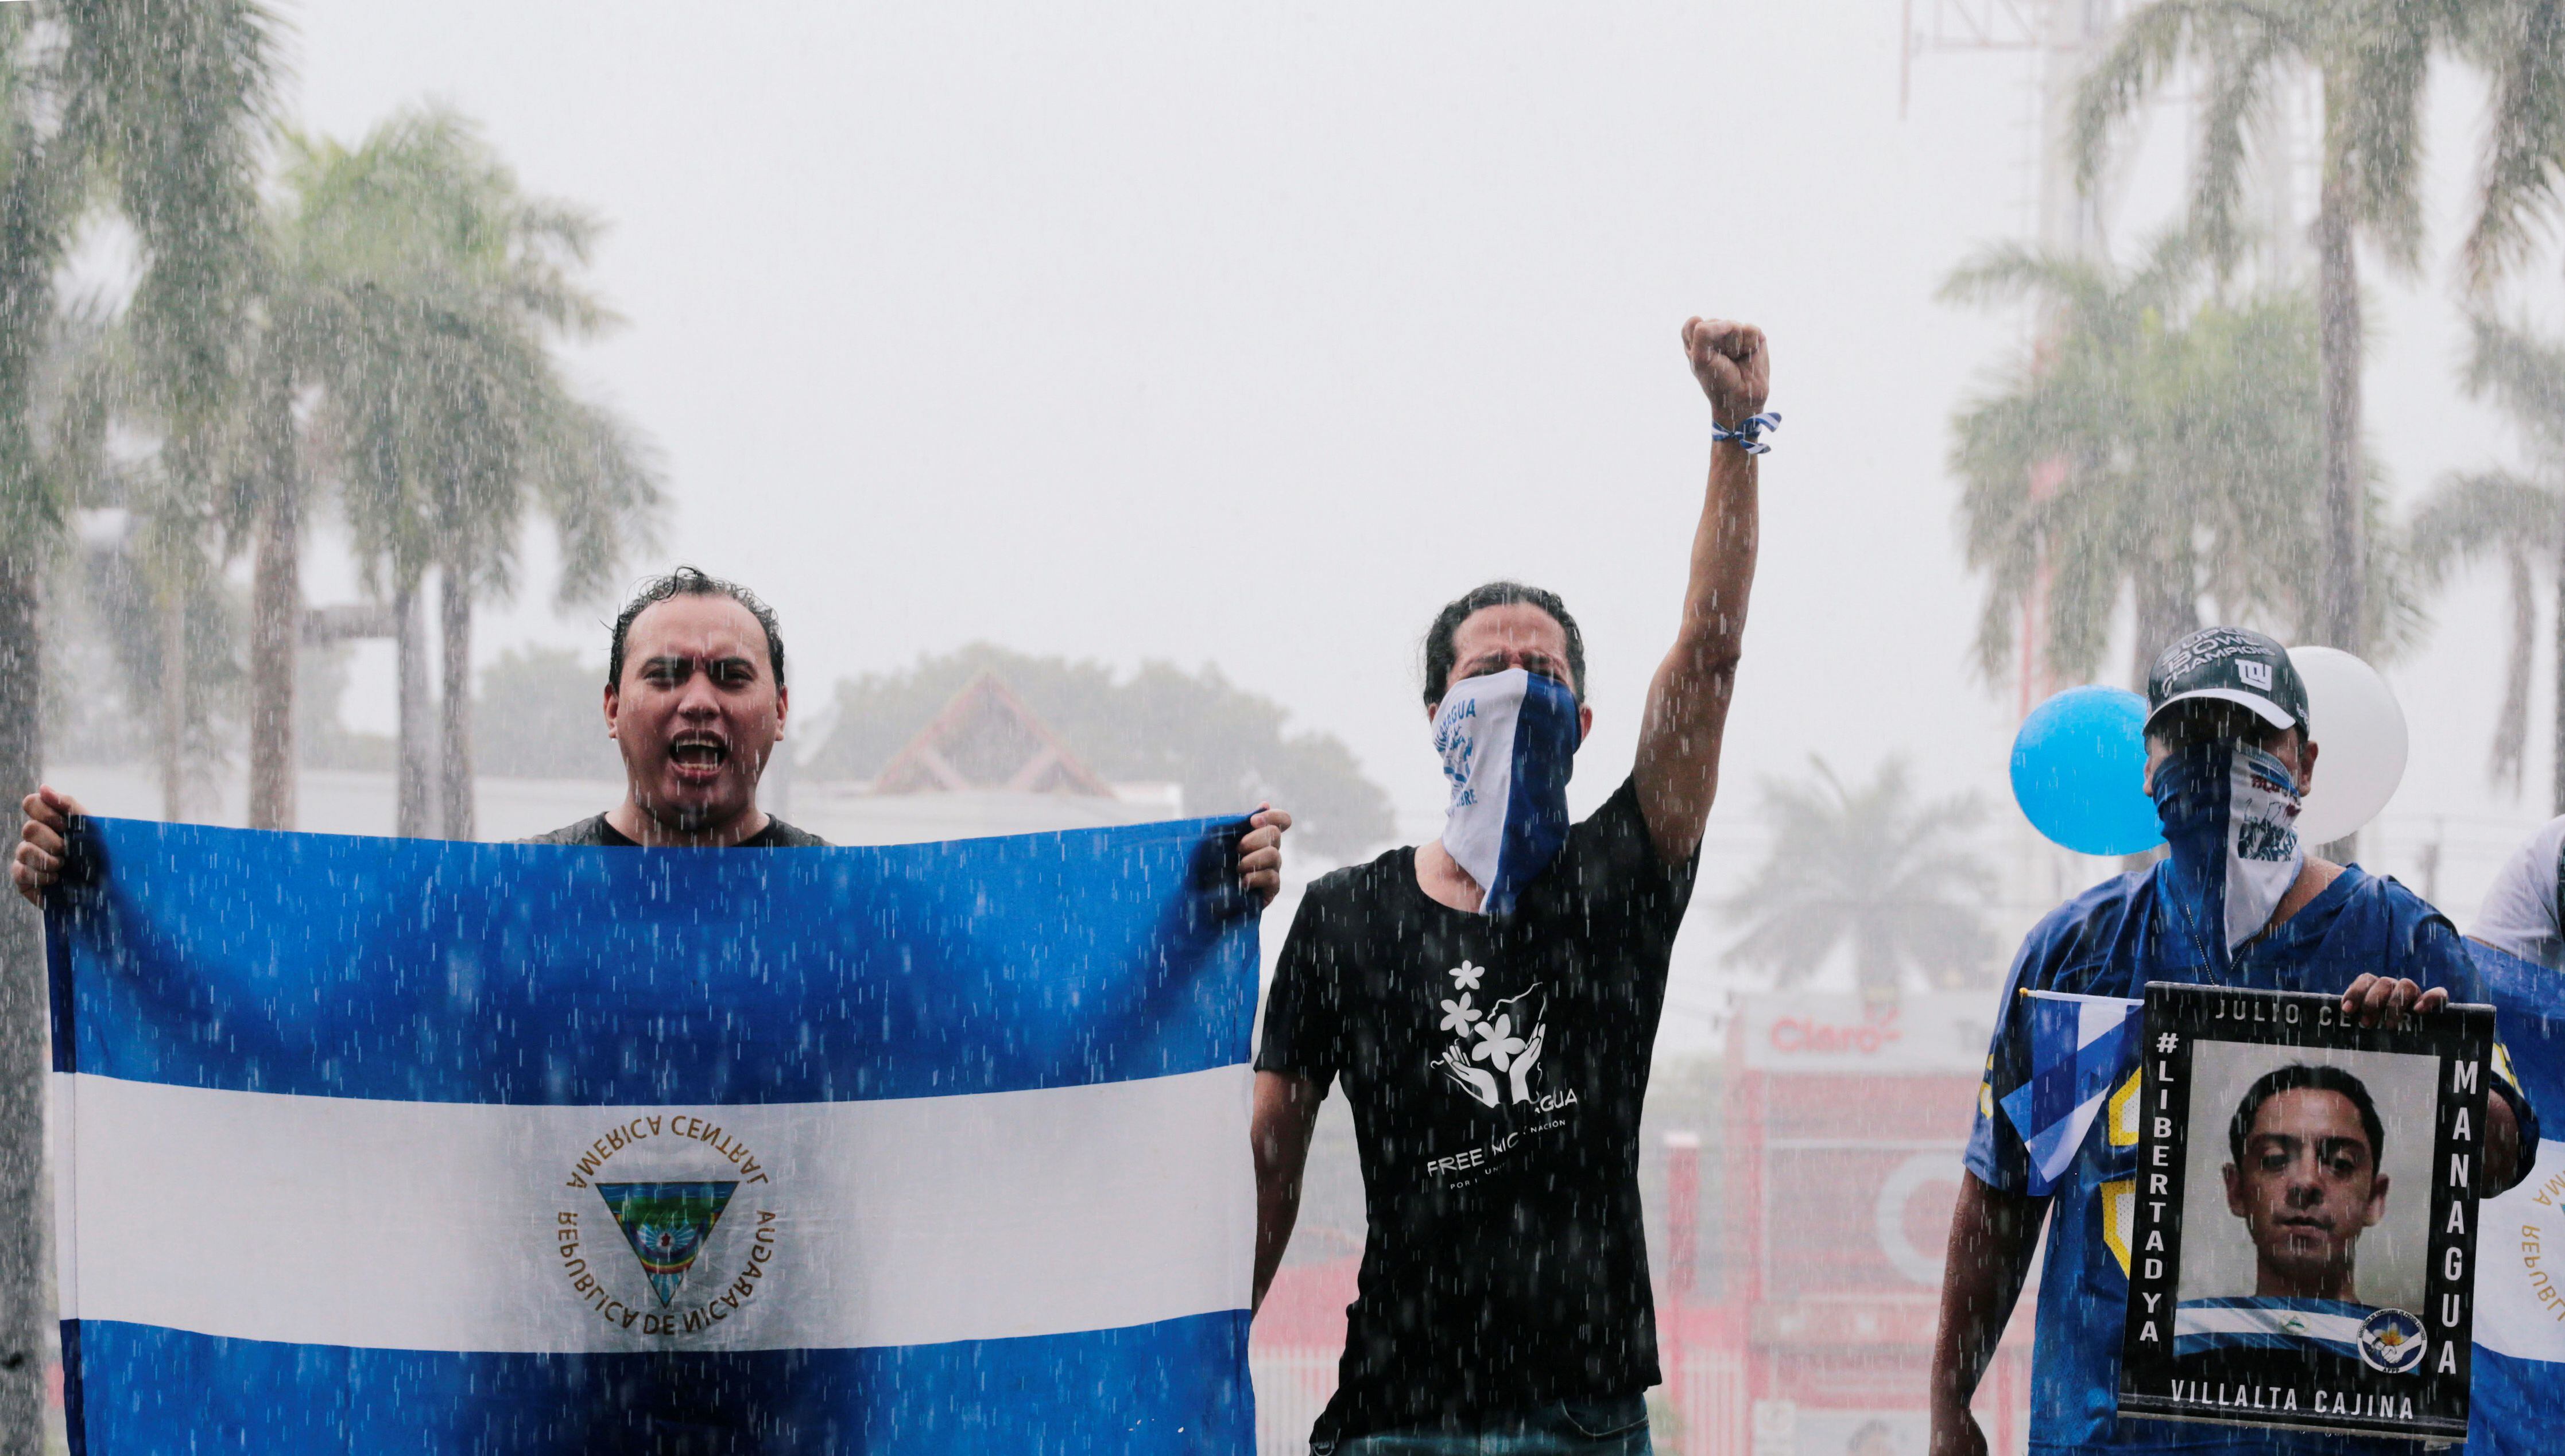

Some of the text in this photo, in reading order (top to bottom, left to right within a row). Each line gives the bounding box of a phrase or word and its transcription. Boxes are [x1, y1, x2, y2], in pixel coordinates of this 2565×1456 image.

[2162, 635, 2262, 673] BOWL
[2162, 646, 2275, 698] CHAMPIONS
[2215, 999, 2411, 1031] JULIO CER
[1770, 1015, 1880, 1054] Claro
[1427, 1148, 1485, 1177] FREE
[1450, 1180, 1470, 1189] POR
[2438, 1061, 2477, 1374] MANAGUA
[2171, 1379, 2413, 1419] VILLALTA CAJINA
